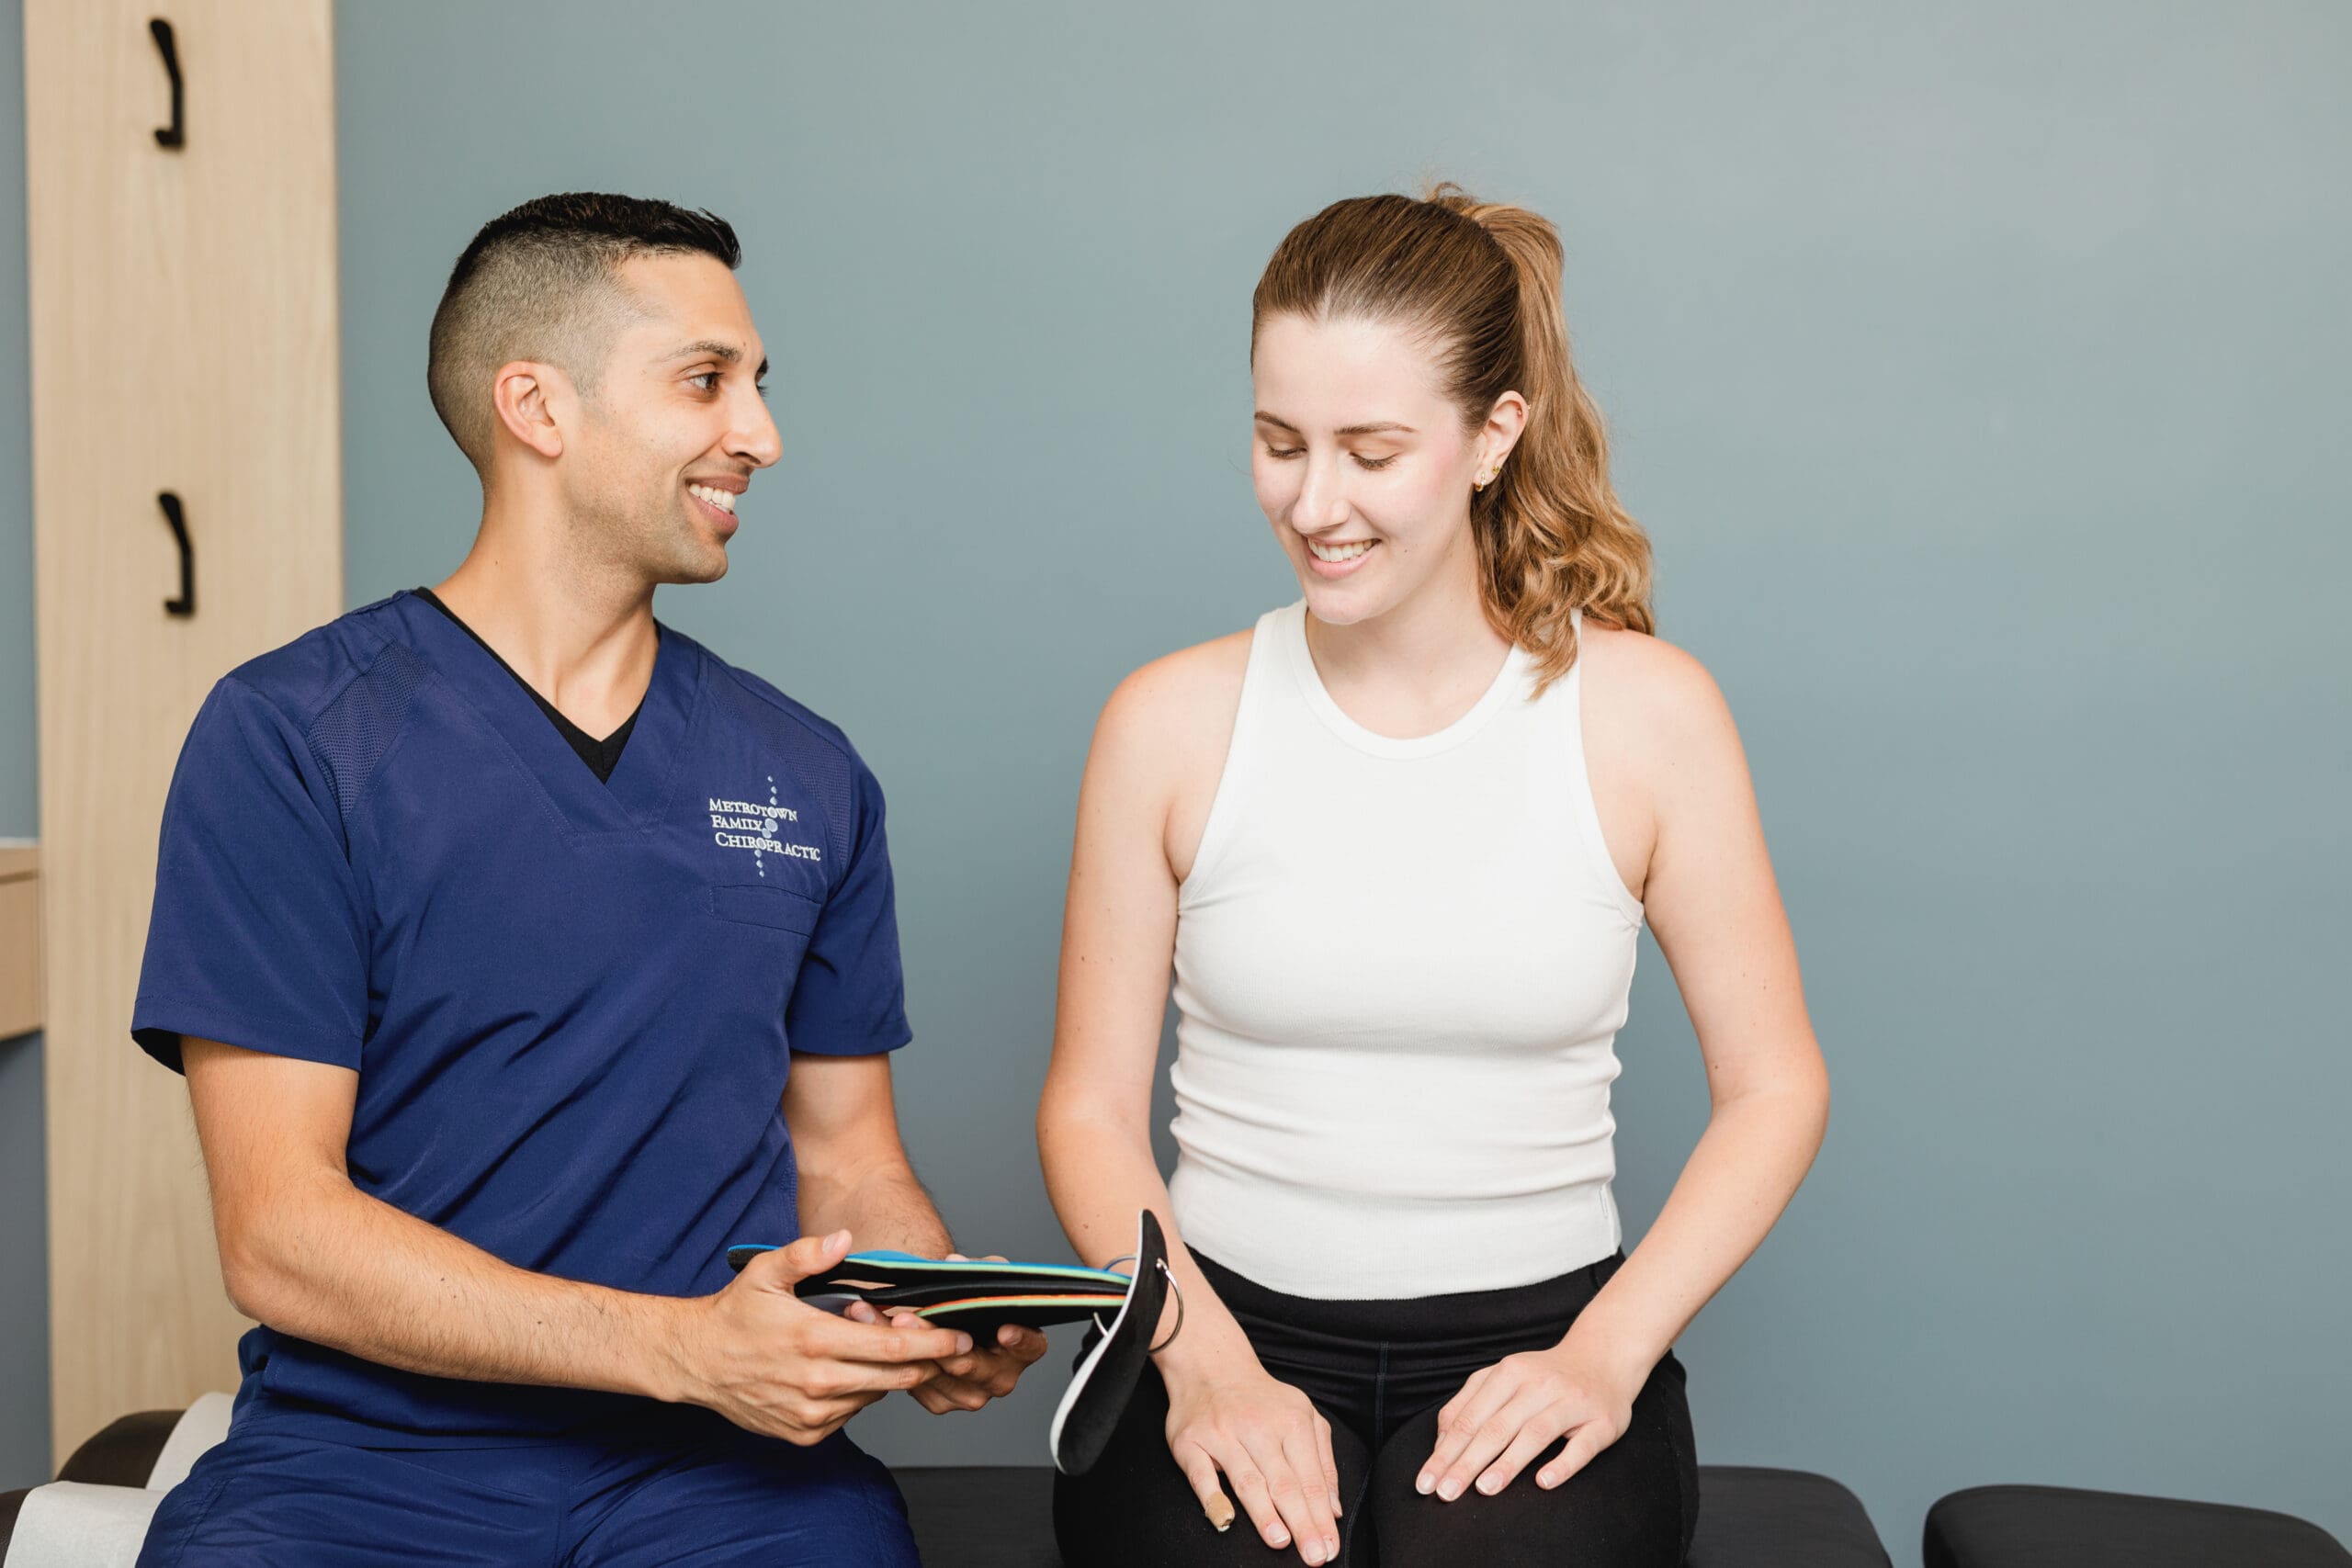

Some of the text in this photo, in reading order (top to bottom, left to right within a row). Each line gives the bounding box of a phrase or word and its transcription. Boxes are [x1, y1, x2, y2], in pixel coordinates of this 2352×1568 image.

[709, 798, 797, 822] METROTOWN
[710, 815, 763, 831] FAMILY
[715, 832, 820, 861] CHIROPRACTIC
